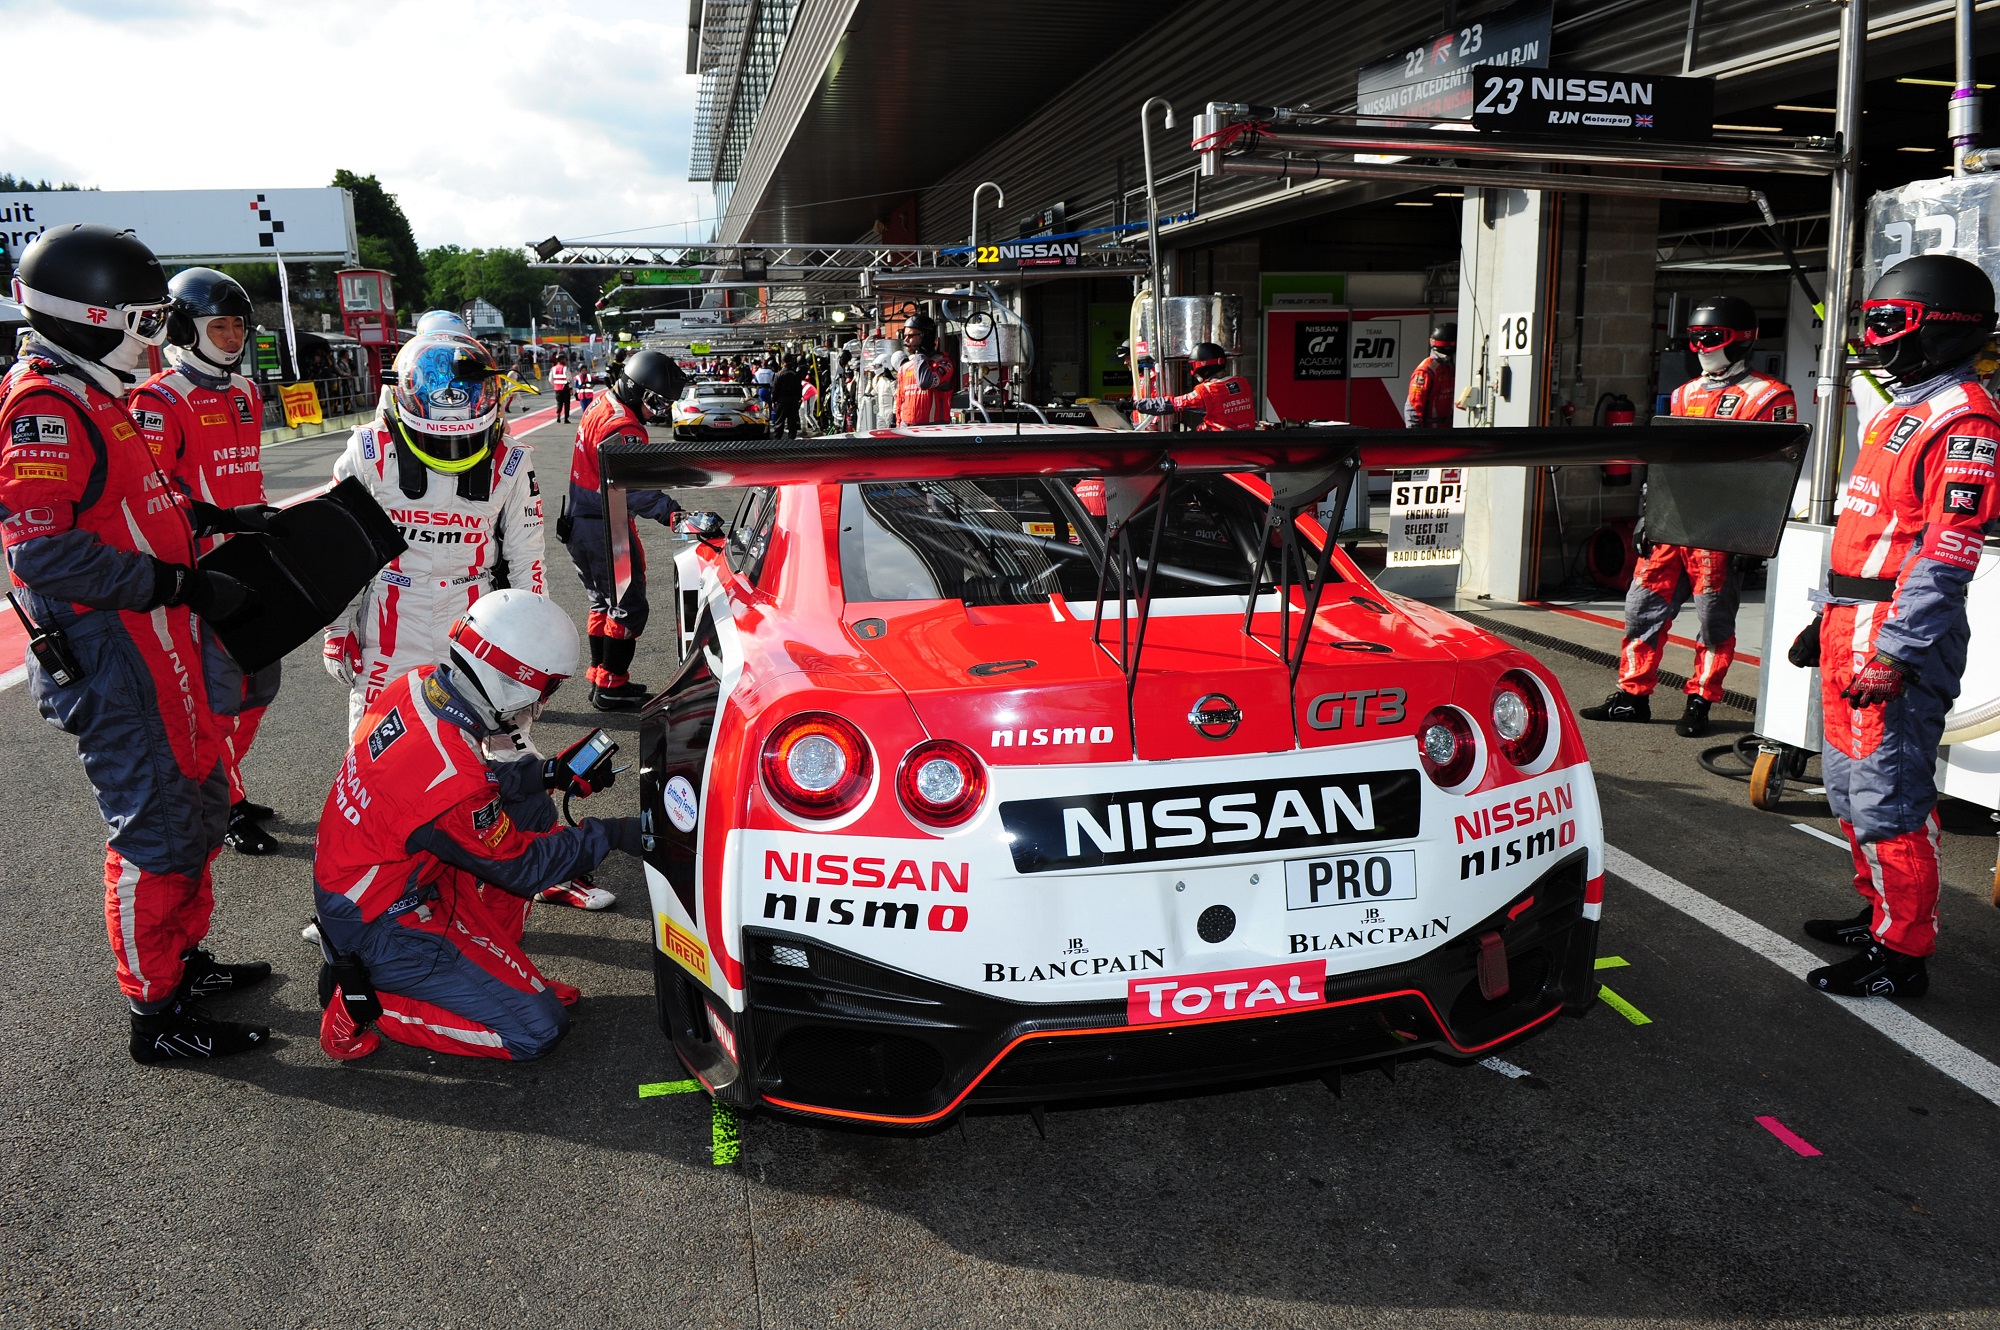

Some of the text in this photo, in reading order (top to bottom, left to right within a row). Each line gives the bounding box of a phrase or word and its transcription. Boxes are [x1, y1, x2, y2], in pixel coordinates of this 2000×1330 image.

[1405, 24, 1482, 78] 22 23
[1363, 90, 1399, 115] NISSAN
[1400, 86, 1415, 106] GT
[1511, 40, 1539, 67] RJN
[1476, 77, 1523, 114] 23
[1532, 77, 1653, 105] NISSAN
[1548, 111, 1630, 125] RJN Motorsport
[977, 243, 1079, 263] 22 NISSAN
[1502, 316, 1528, 350] 18
[1299, 357, 1343, 366] ACADEMY
[1309, 368, 1341, 377] PlayStation
[426, 422, 475, 432] NISSAN
[9, 449, 69, 460] nismo
[213, 446, 260, 462] NISSAN
[1945, 466, 1996, 478] nismo
[1396, 485, 1461, 506] STOP!
[390, 509, 482, 529] NISSAN
[1406, 508, 1449, 520] ENGINE OFF
[28, 524, 56, 534] GROUP
[396, 526, 483, 544] nismo
[1405, 523, 1449, 535] SELECT 1ST
[1416, 535, 1437, 546] GEAR
[1394, 549, 1456, 562] RADIO CONTACT
[381, 573, 411, 586] sparco
[445, 705, 480, 730] nismo
[1307, 687, 1408, 731] GT3
[991, 726, 1115, 748] nismo
[667, 783, 683, 808] Brittany
[1062, 784, 1376, 857] NISSAN
[1454, 783, 1573, 845] NISSAN
[1460, 819, 1576, 881] nismo
[764, 849, 970, 893] NISSAN
[1308, 854, 1394, 903] PRO
[387, 896, 418, 914] sparco
[763, 893, 969, 933] nismo
[1365, 908, 1380, 919] JB
[1068, 937, 1084, 949] JB
[1288, 916, 1452, 954] BLANCPAIN
[665, 923, 706, 976] PIRELLI
[1062, 947, 1090, 956] 1735
[983, 948, 1166, 983] BLANCPAIN
[1134, 974, 1321, 1019] TOTAL
[707, 1007, 737, 1058] MOTUL
